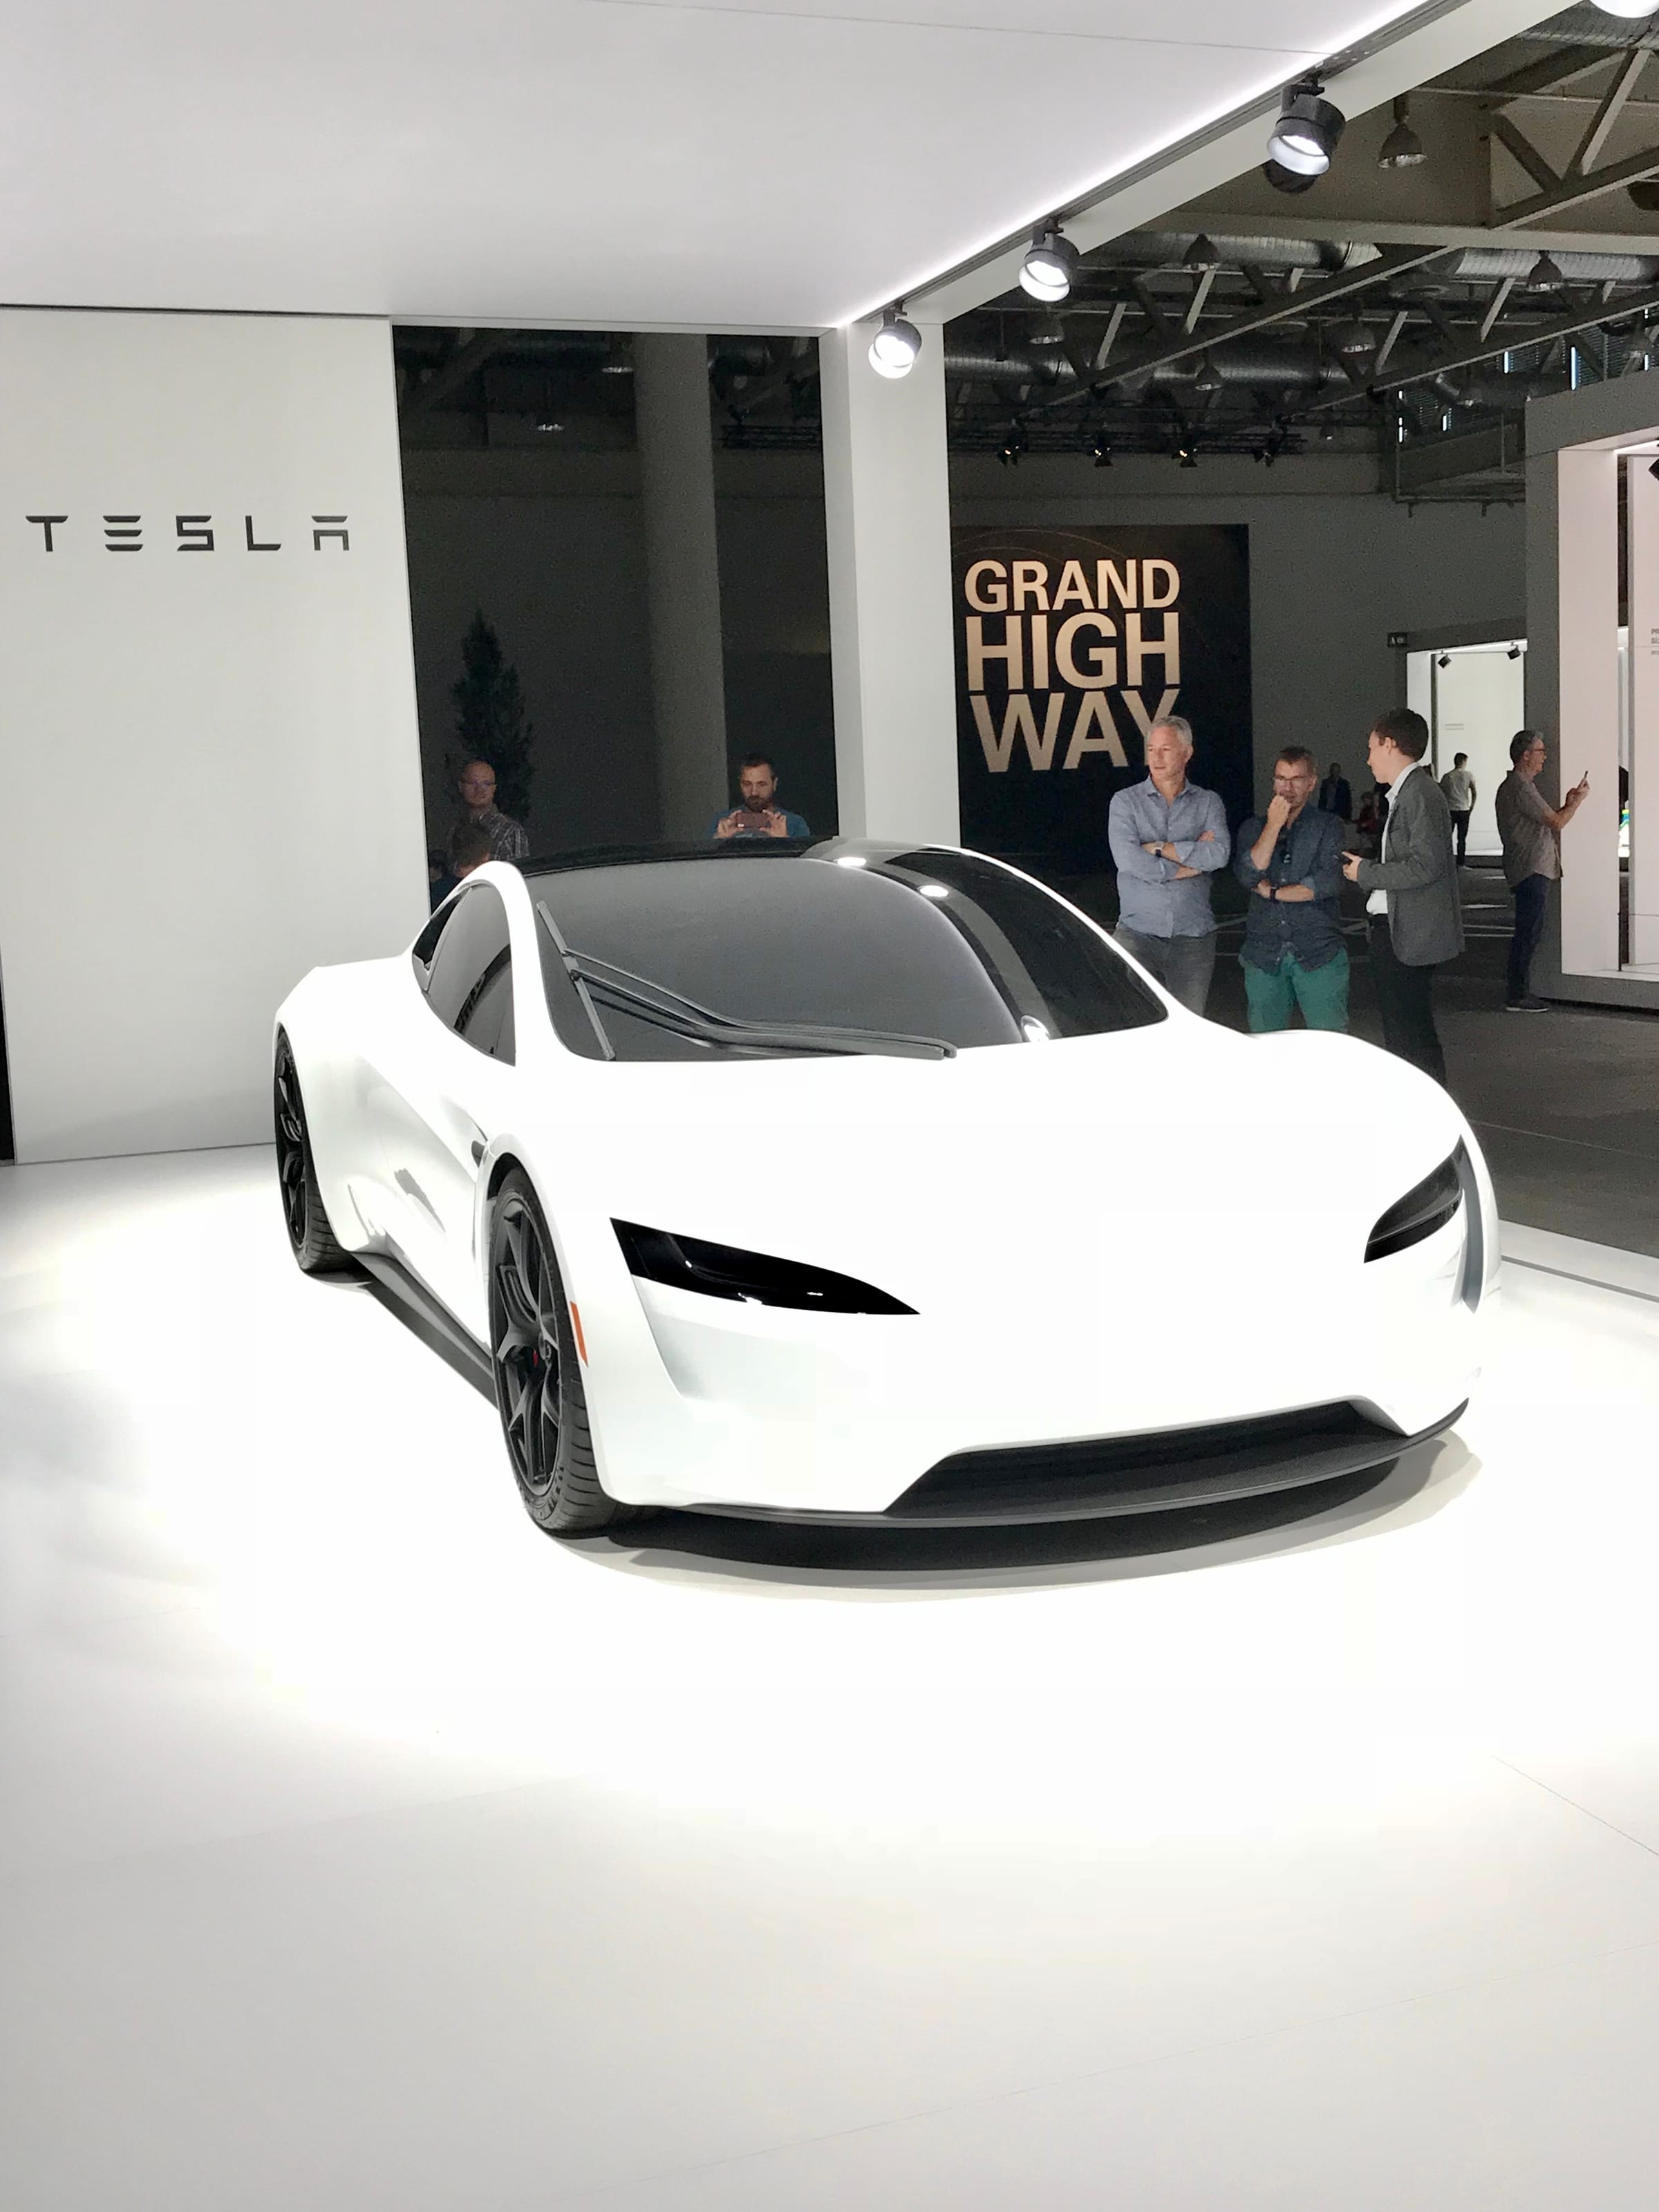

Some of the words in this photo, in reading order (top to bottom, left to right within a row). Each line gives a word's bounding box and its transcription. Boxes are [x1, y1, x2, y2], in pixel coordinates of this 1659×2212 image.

[26, 515, 350, 552] TESLA
[964, 559, 1181, 612] GRAND
[966, 612, 1181, 691] HIGH
[969, 688, 1181, 773] WAY
